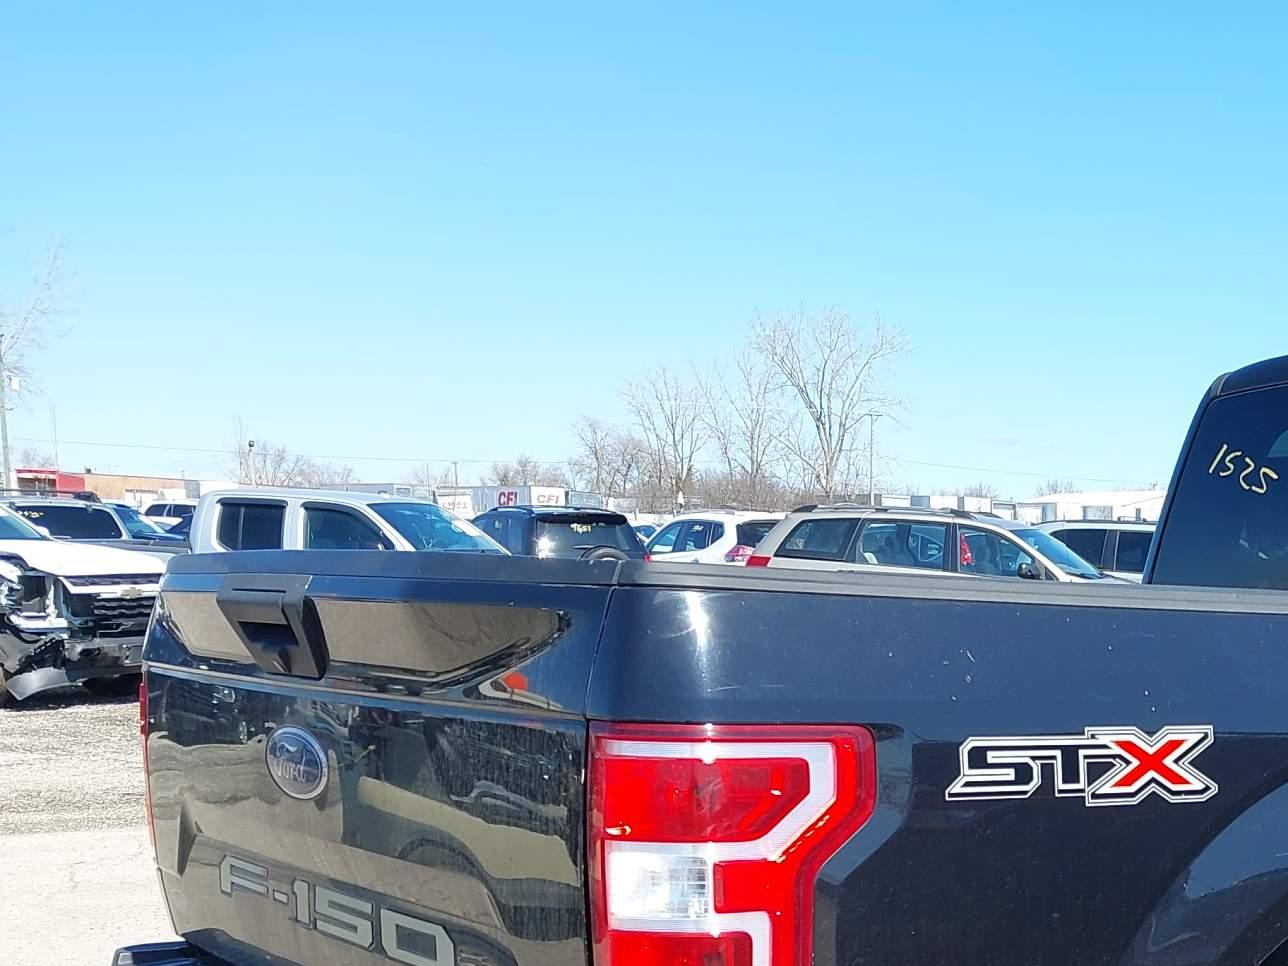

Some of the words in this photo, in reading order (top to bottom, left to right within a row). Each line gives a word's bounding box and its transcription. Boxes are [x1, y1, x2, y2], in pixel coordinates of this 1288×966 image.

[1208, 443, 1279, 494] 1525
[498, 491, 518, 506] CFI
[536, 494, 560, 505] CFI
[945, 725, 1219, 807] STX
